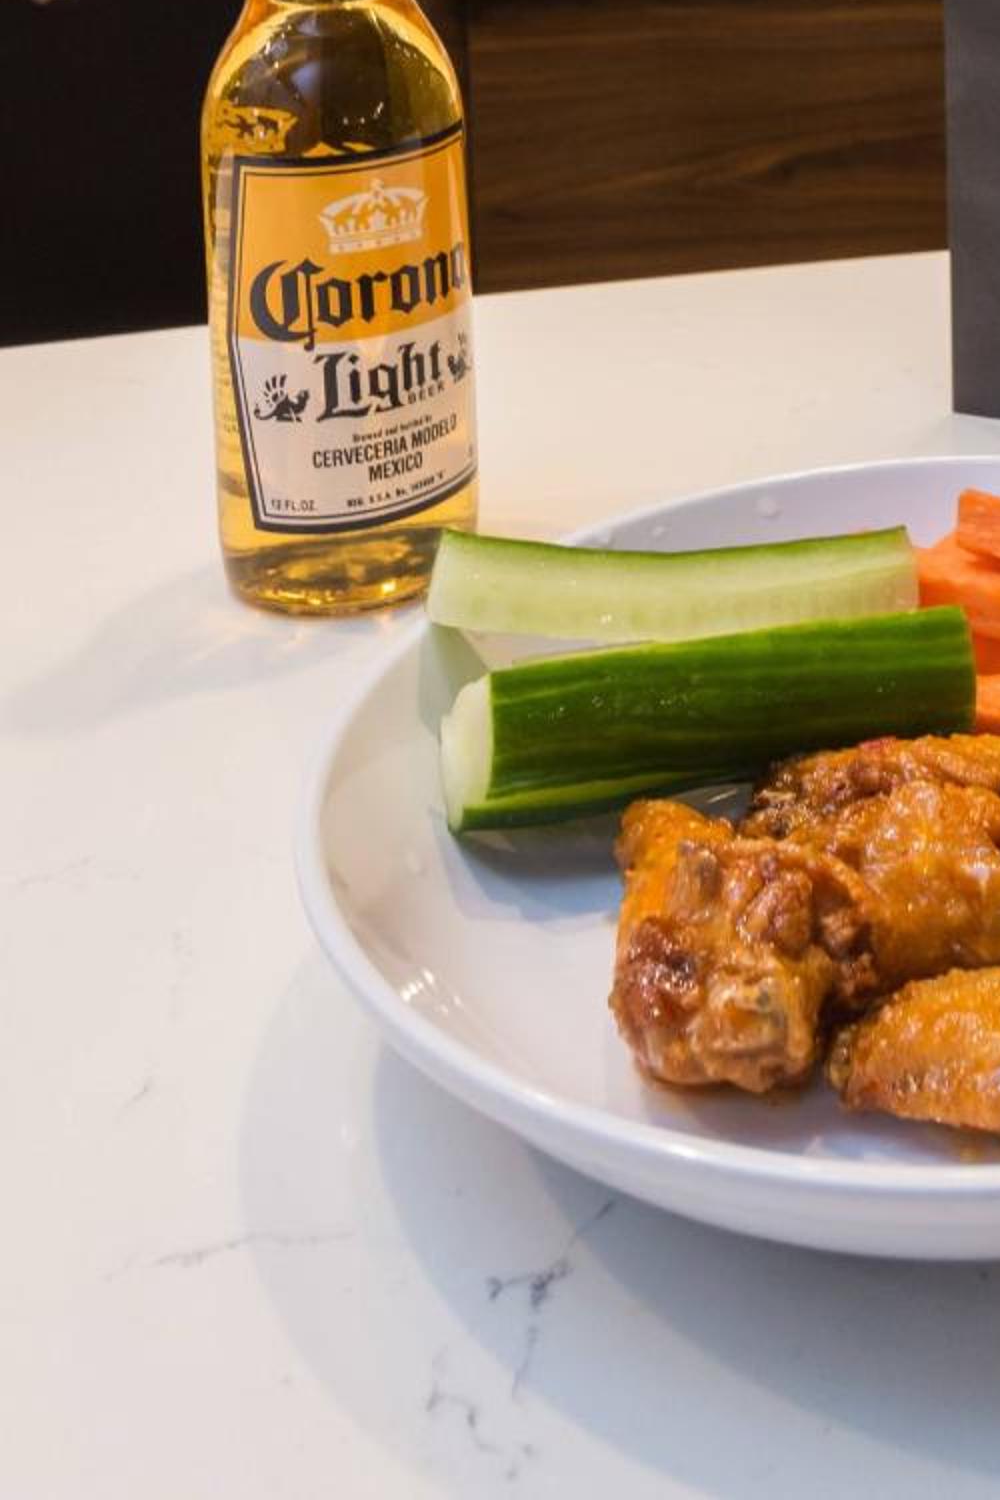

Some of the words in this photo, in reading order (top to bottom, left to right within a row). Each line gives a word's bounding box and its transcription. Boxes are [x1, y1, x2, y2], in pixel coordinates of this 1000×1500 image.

[314, 340, 441, 423] Light
[312, 435, 409, 469] CERVECERIA
[411, 413, 457, 449] MODELO
[367, 451, 423, 482] MEXICO
